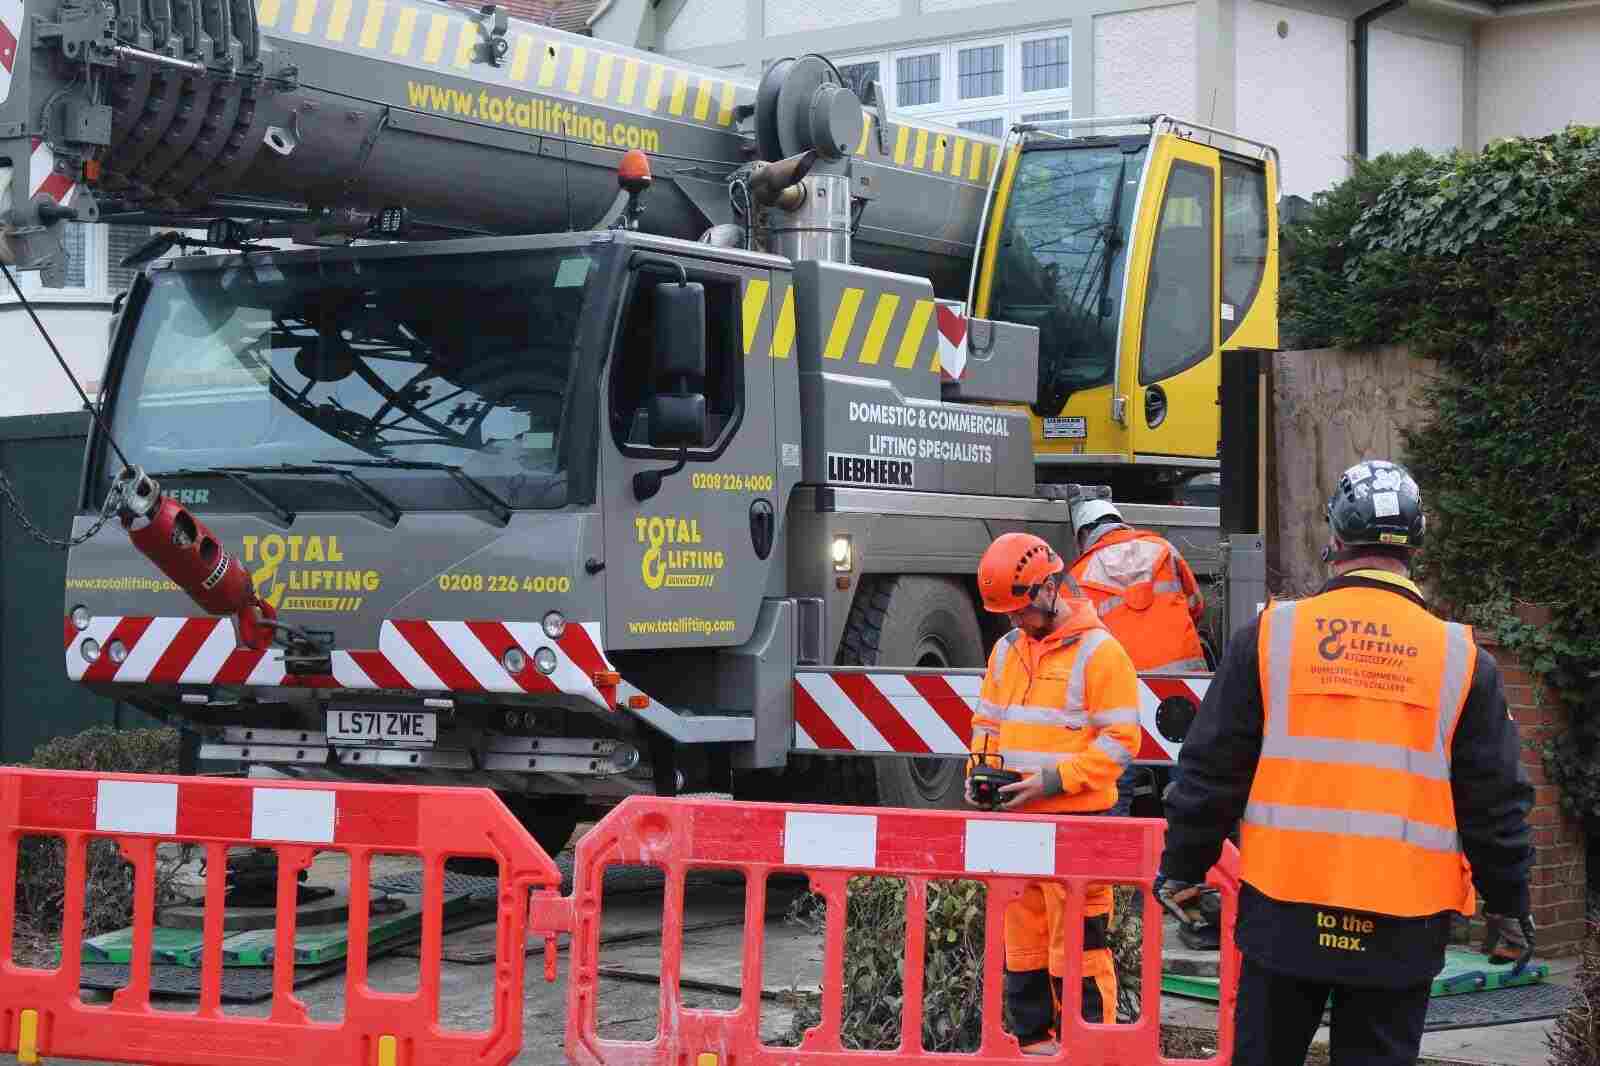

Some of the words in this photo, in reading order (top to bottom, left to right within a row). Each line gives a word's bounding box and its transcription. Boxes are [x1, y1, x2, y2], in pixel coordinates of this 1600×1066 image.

[407, 80, 658, 152] www.totallifting.com
[849, 402, 917, 427] DOMESTIC
[919, 411, 927, 428] &
[928, 413, 1009, 437] COMMERCIAL
[869, 434, 917, 457] LIFTING
[918, 440, 993, 463] SPECIALISTS
[828, 455, 913, 486] LIEBHERR
[692, 473, 721, 490] 0208
[723, 474, 743, 490] 226
[744, 475, 773, 492] 4000
[635, 517, 703, 544] TOTAL
[242, 534, 344, 562] TOTAL
[668, 551, 724, 569] LIFTING
[66, 577, 183, 593] www.totallifting.co
[288, 570, 380, 591] LIFTING
[439, 575, 483, 591] 0208
[488, 576, 519, 592] 226
[522, 576, 570, 592] 4000
[628, 617, 736, 636] www.totallifting.com
[1315, 618, 1392, 637] TOTAL
[1351, 638, 1418, 657] LIFTING
[338, 713, 381, 735] LS71
[386, 714, 424, 736] ZWE
[1316, 911, 1337, 928] to
[1343, 914, 1375, 933] the
[1319, 932, 1366, 951] max.
